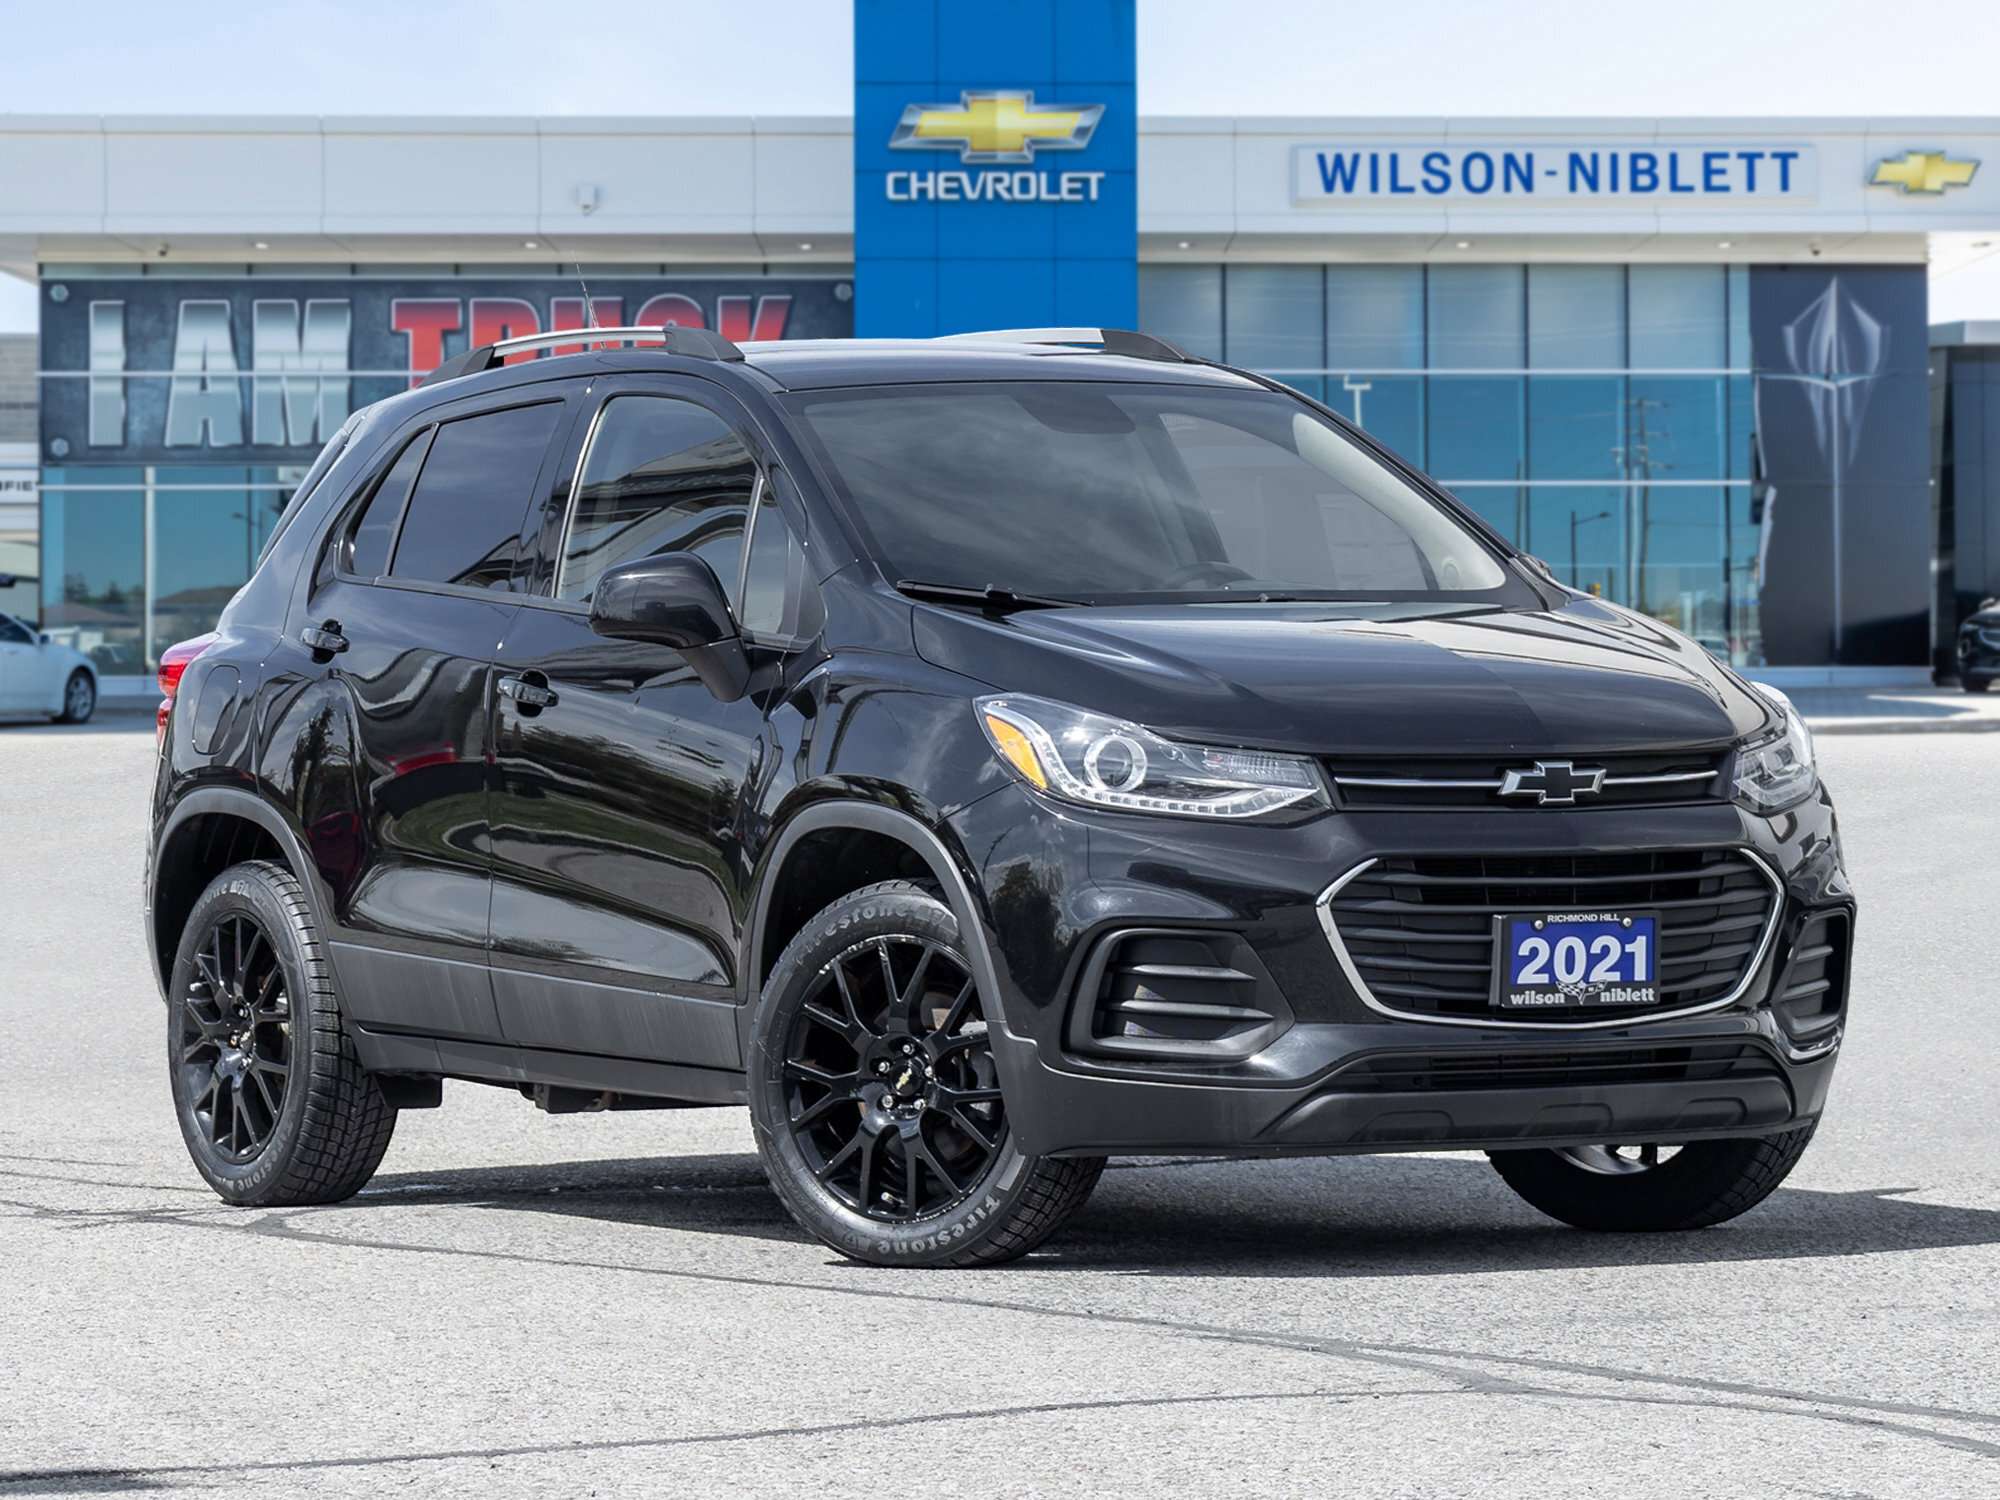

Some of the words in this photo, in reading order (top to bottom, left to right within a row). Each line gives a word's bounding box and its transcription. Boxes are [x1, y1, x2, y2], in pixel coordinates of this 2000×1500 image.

[886, 171, 1105, 201] CHEVROLET
[1316, 151, 1799, 195] WILSON-NIBLETT
[88, 299, 126, 447] I
[164, 298, 353, 447] AM
[1547, 914, 1598, 923] RICHMOND
[1599, 913, 1620, 922] HILL
[1516, 934, 1648, 985] 2021
[1510, 990, 1566, 1006] wilson
[1601, 987, 1655, 1004] niblett
[877, 1194, 1000, 1255] Firestone
